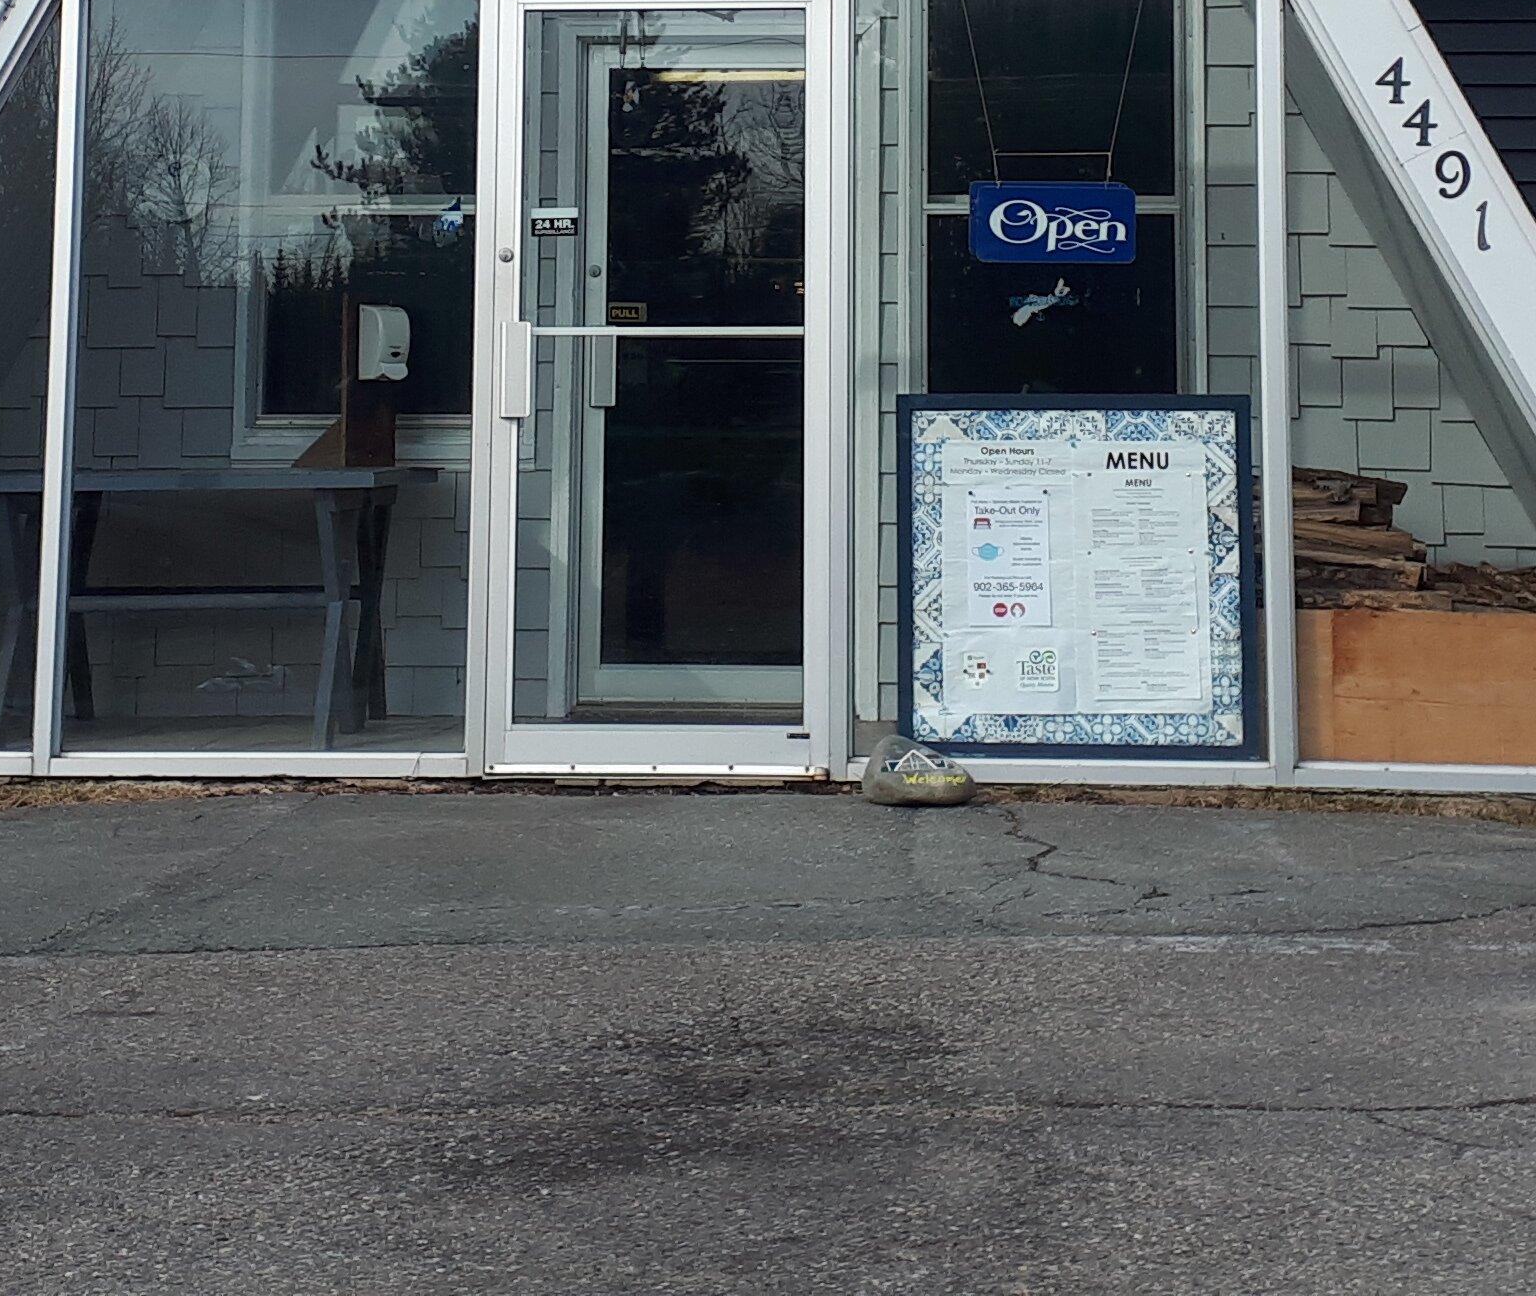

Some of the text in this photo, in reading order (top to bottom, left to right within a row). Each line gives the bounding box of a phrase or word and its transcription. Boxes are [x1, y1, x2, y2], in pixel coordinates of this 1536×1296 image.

[1375, 56, 1491, 252] 4491
[534, 219, 551, 230] 24
[989, 199, 1127, 254] Open
[611, 307, 639, 318] PULL
[980, 446, 1035, 456] Open Hours
[1005, 457, 1034, 466] Sunday
[1105, 451, 1169, 470] MENU
[1124, 478, 1152, 487] MENU
[974, 505, 1041, 516] Take-Out Only
[1016, 660, 1056, 676] Taste
